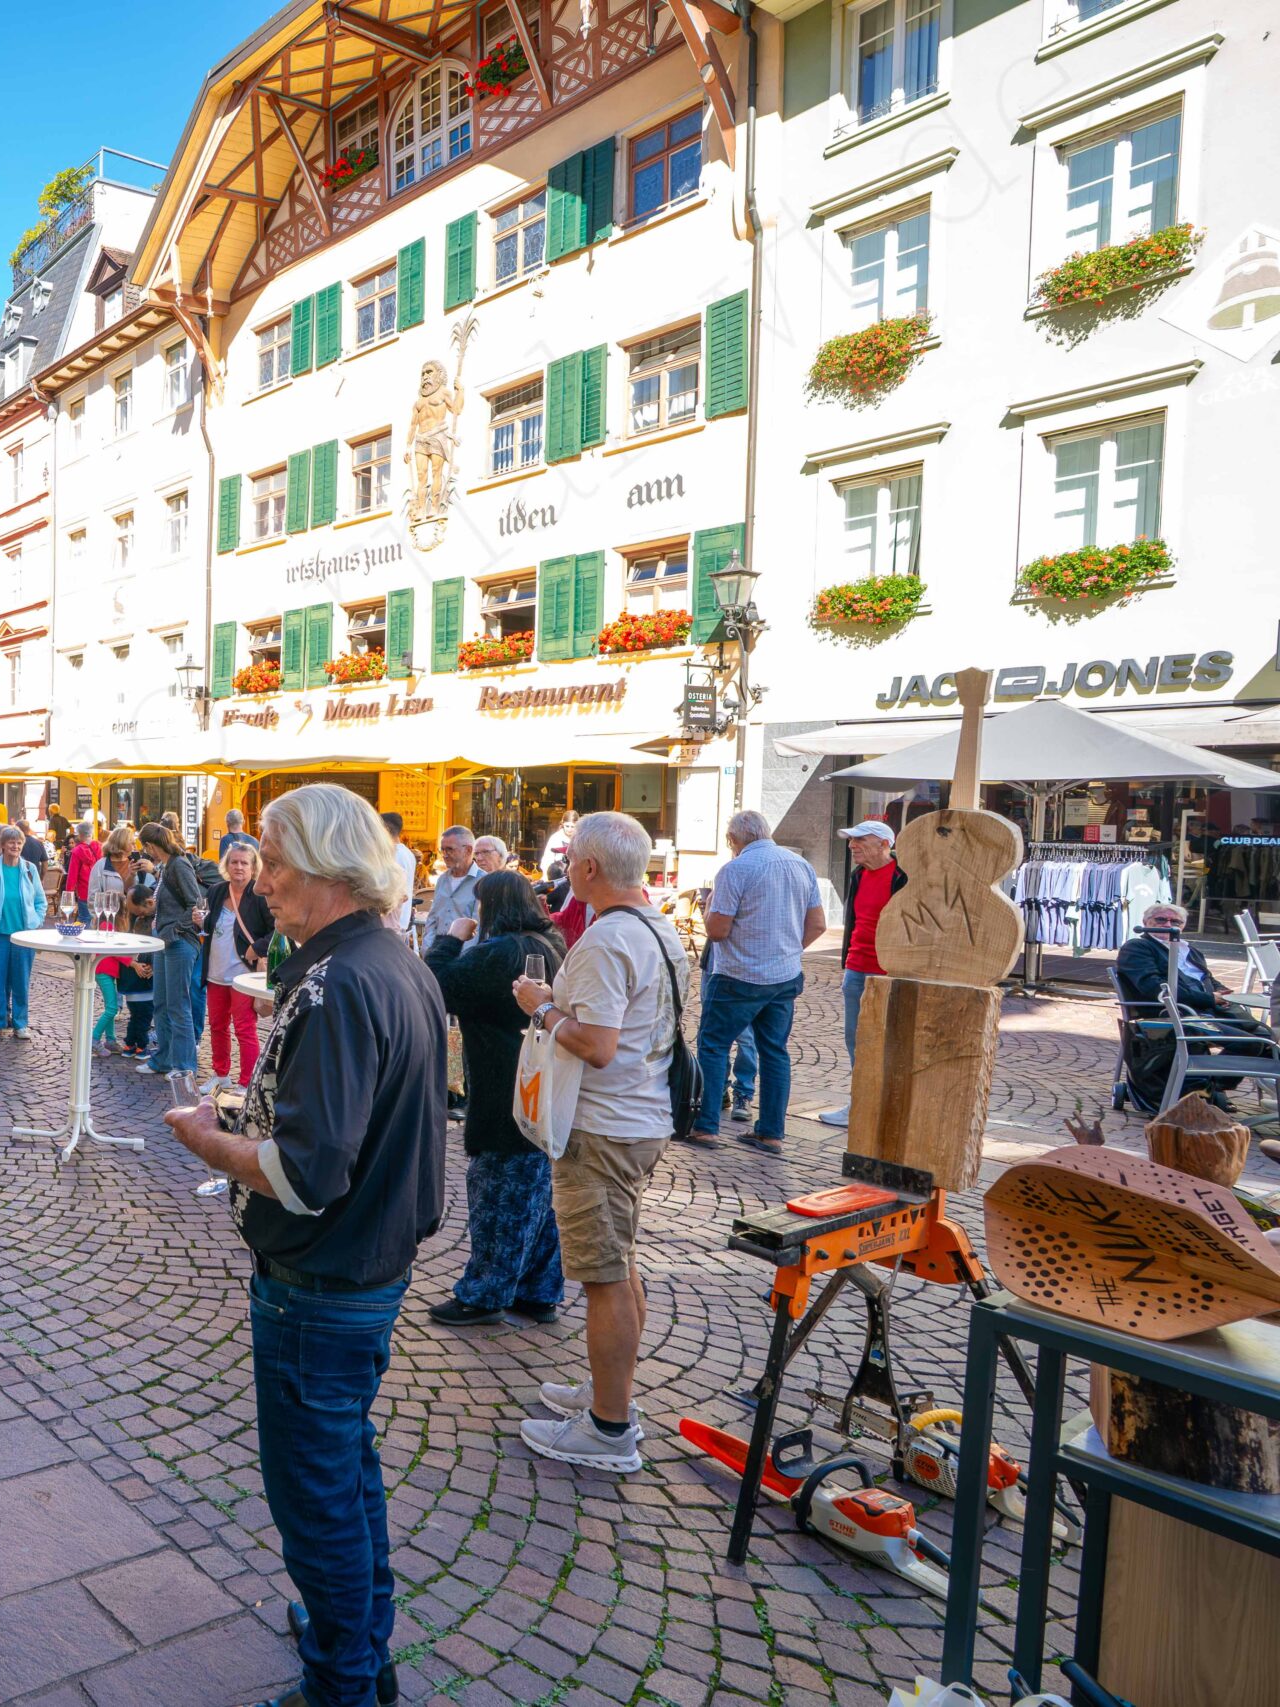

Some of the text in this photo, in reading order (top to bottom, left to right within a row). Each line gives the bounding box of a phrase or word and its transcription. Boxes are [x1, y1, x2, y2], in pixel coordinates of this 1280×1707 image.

[877, 650, 1234, 705] JAC JONES
[323, 693, 434, 722] Mona Lisa
[476, 677, 628, 711] Restaurant
[687, 692, 713, 700] OSTERIA
[1220, 836, 1251, 845] CLUB
[1043, 1181, 1177, 1285] NUKE
[1160, 1208, 1255, 1272] TARGET
[829, 1519, 857, 1534] STIHL
